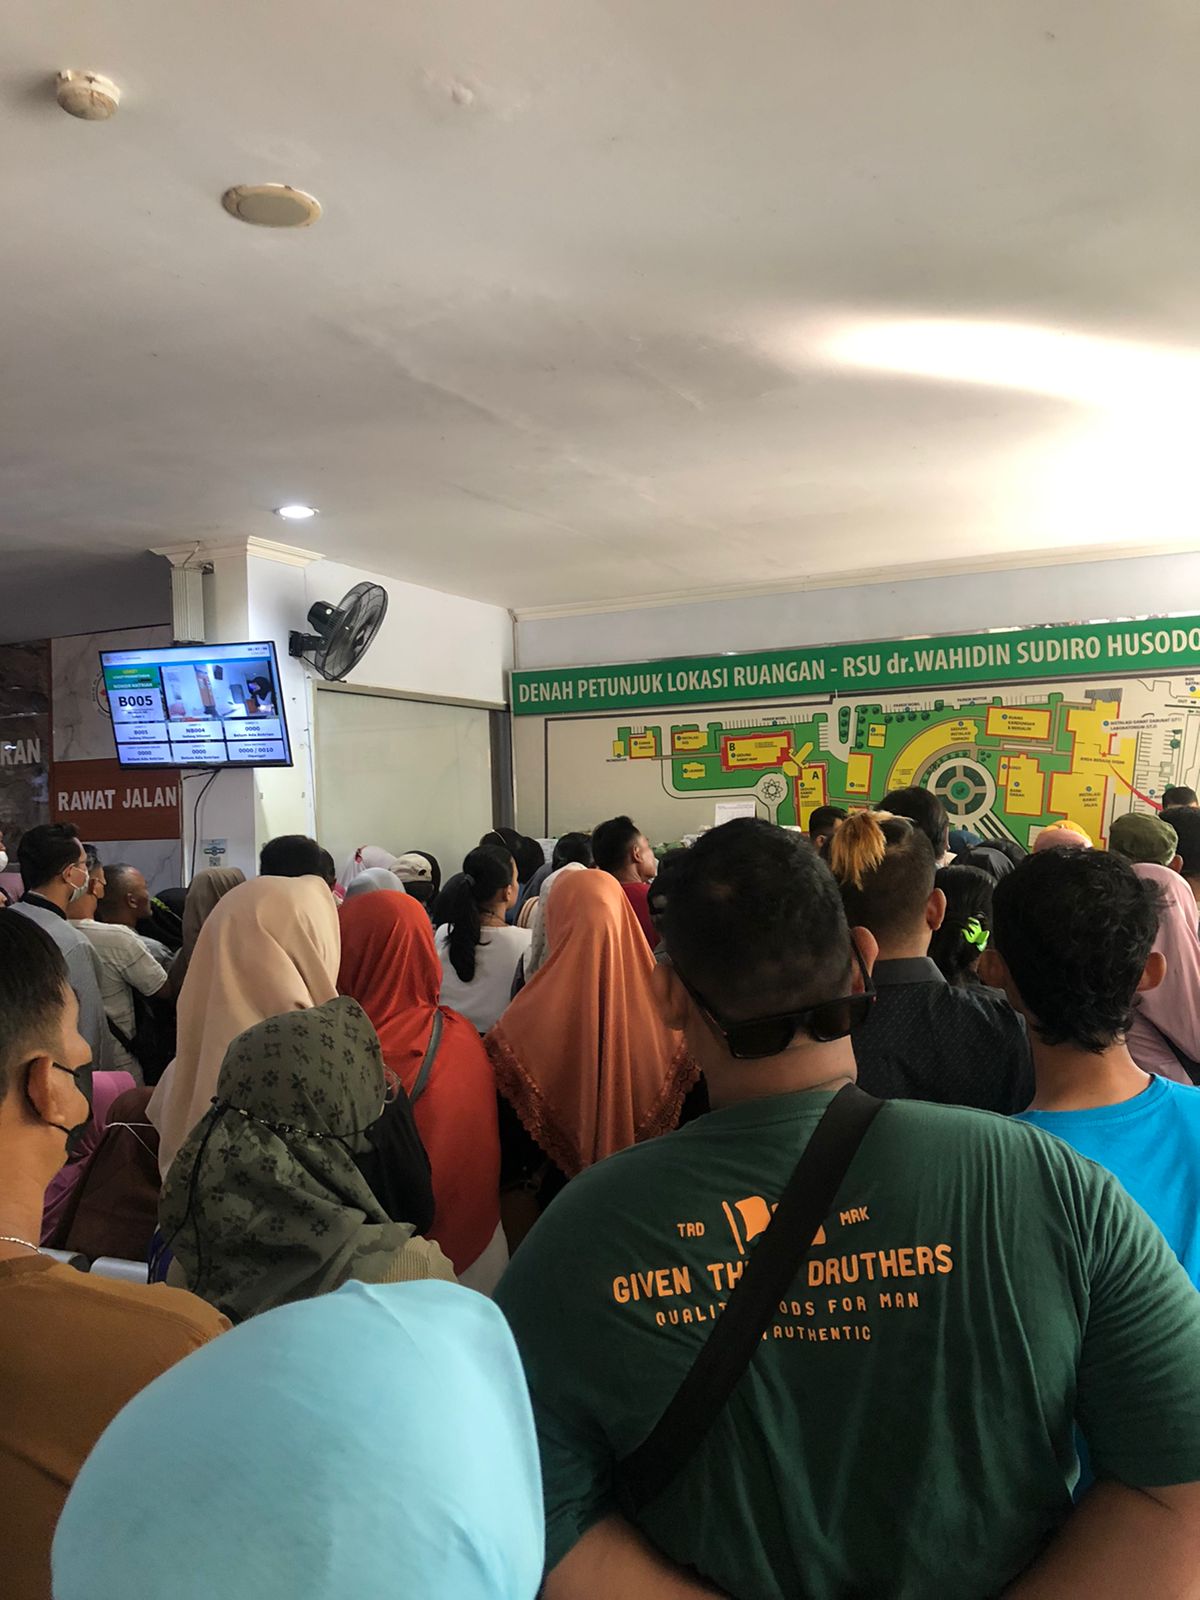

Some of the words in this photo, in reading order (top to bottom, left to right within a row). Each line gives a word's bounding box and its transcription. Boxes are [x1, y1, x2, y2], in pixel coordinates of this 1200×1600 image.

[519, 681, 573, 703] DENAH
[578, 673, 663, 698] PETUNJUK
[667, 668, 728, 692] LOKASI
[734, 659, 825, 687] RUANGAN
[842, 654, 881, 678] RSU
[1017, 636, 1100, 664] SUDIRO
[1107, 627, 1200, 657] HUSODO
[118, 695, 153, 707] B005
[729, 743, 736, 751] B
[812, 771, 819, 780] A
[58, 789, 116, 811] RAWAT
[122, 786, 177, 808] JALAN
[839, 1206, 870, 1226] MRK
[677, 1222, 705, 1237] TRD
[612, 1266, 692, 1303] GIVEN
[808, 1244, 953, 1287] DRUTHERS
[655, 1302, 728, 1326] QUALIT
[828, 1296, 867, 1314] FOR
[879, 1292, 919, 1308] MAN
[773, 1325, 871, 1341] AUTHENTIC
